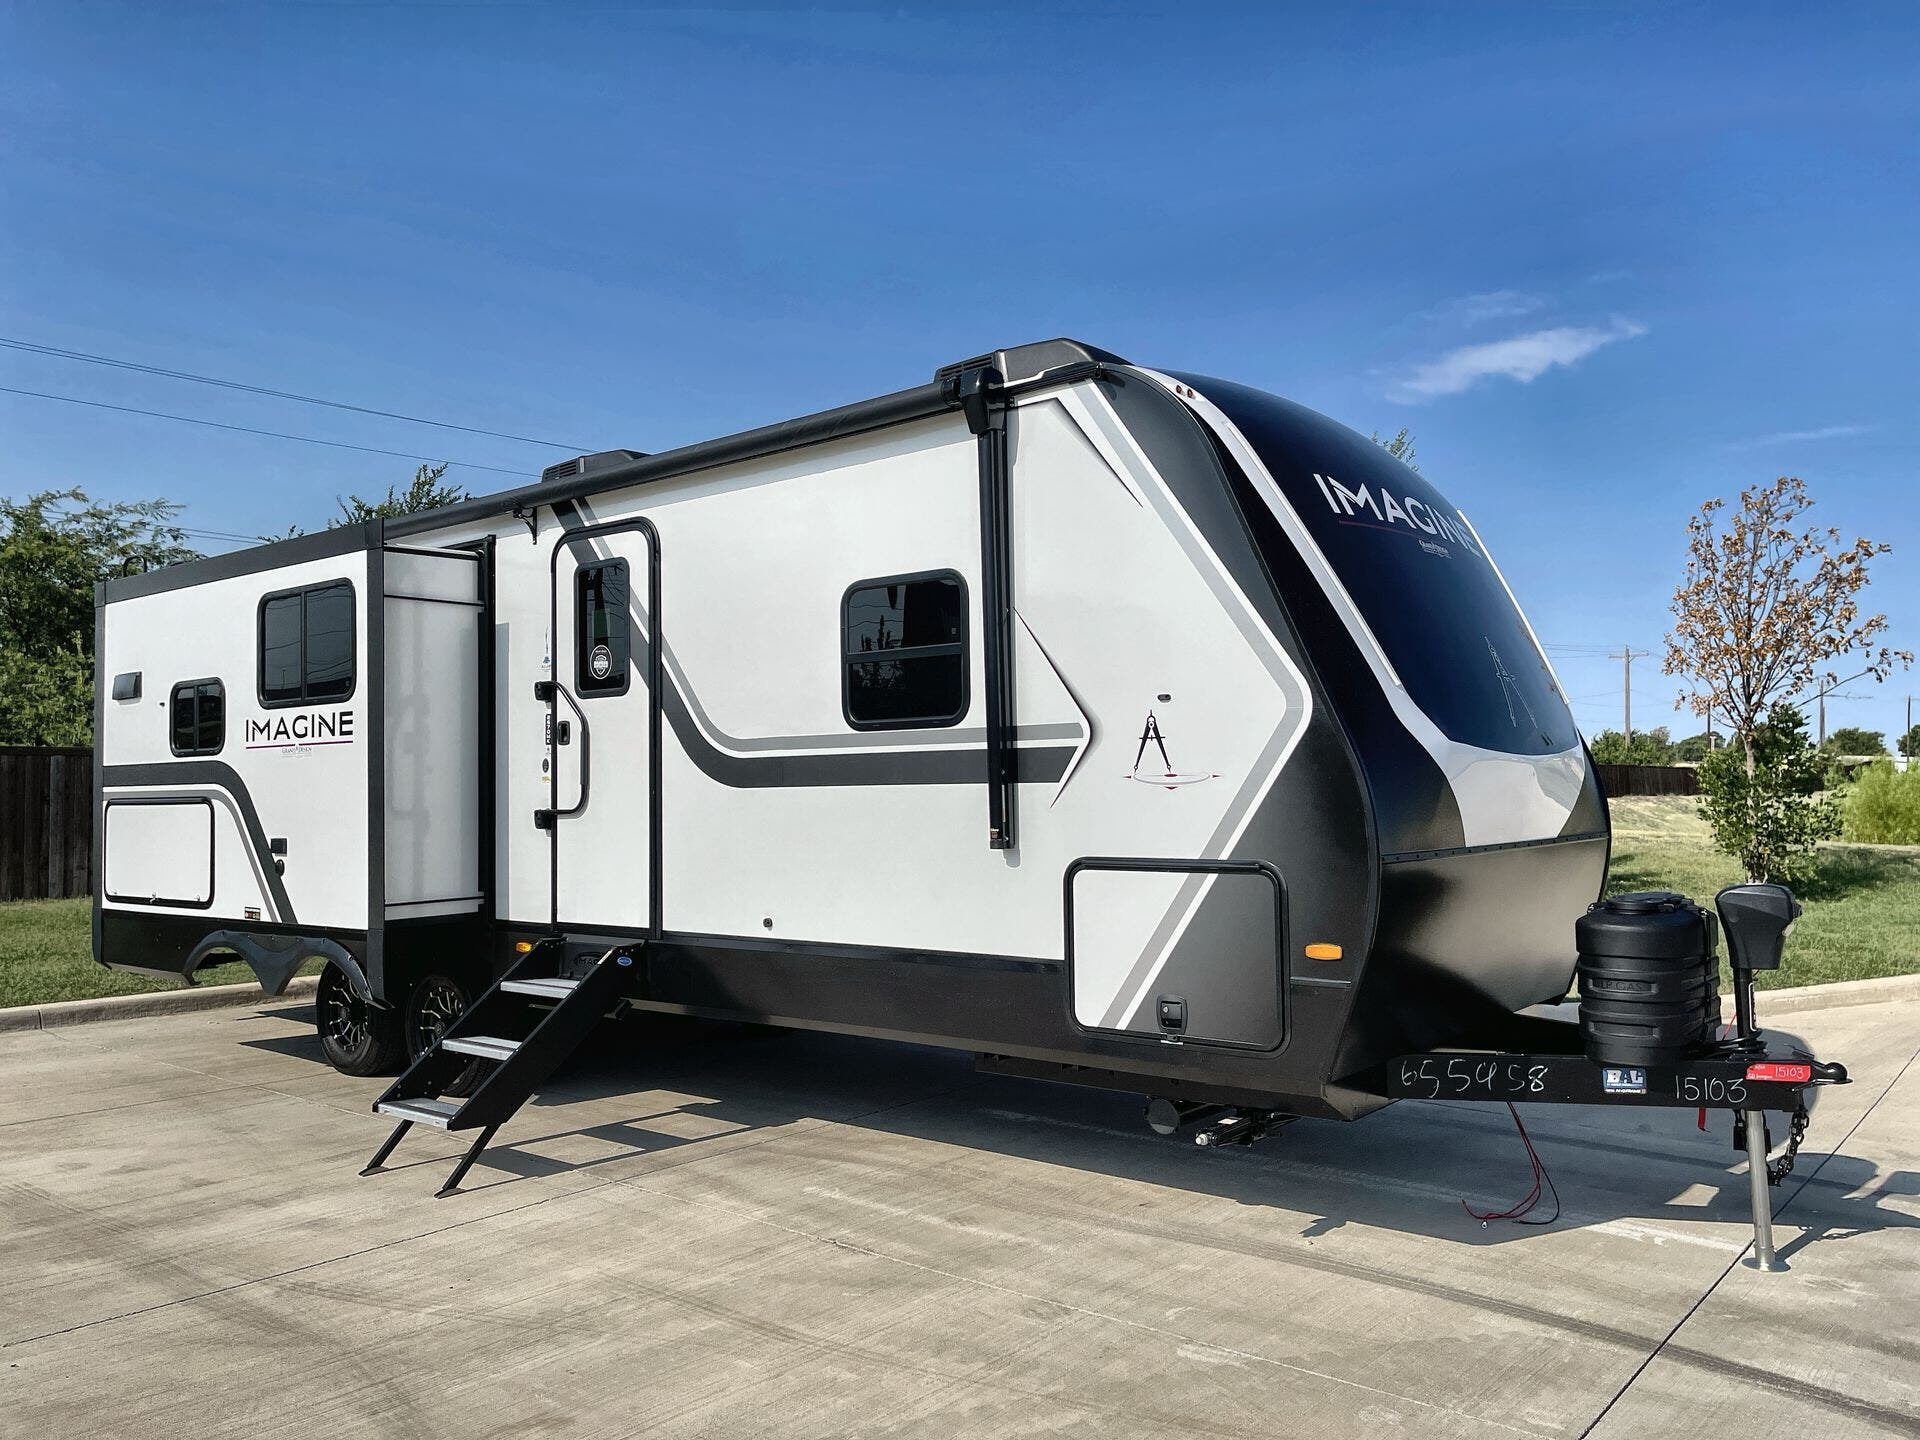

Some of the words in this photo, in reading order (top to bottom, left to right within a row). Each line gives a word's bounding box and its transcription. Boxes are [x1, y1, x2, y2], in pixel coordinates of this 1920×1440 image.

[1313, 473, 1482, 558] IMAGINE
[246, 711, 353, 742] IMAGINE
[1606, 1069, 1644, 1084] BAL
[1775, 1065, 1804, 1080] 15103
[1676, 1074, 1747, 1103] 15103
